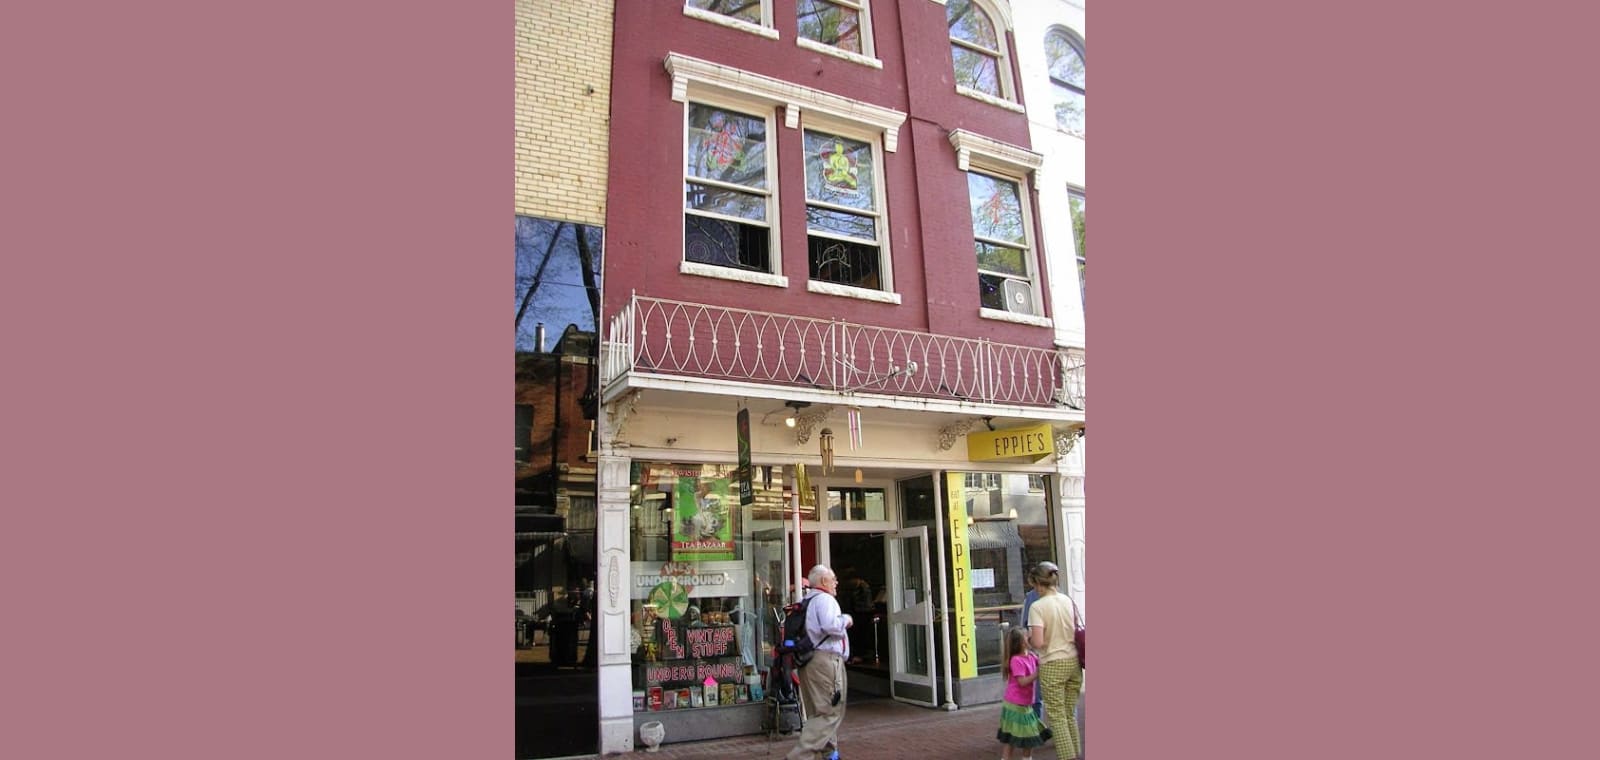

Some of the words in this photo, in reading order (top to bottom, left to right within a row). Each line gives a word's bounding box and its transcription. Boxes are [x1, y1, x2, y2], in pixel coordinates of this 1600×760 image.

[995, 433, 1045, 456] EPPIE'S
[953, 519, 970, 663] EPPIE'S
[662, 618, 685, 659] OPEN
[687, 628, 734, 644] VINTAGE
[692, 642, 727, 658] STUFF
